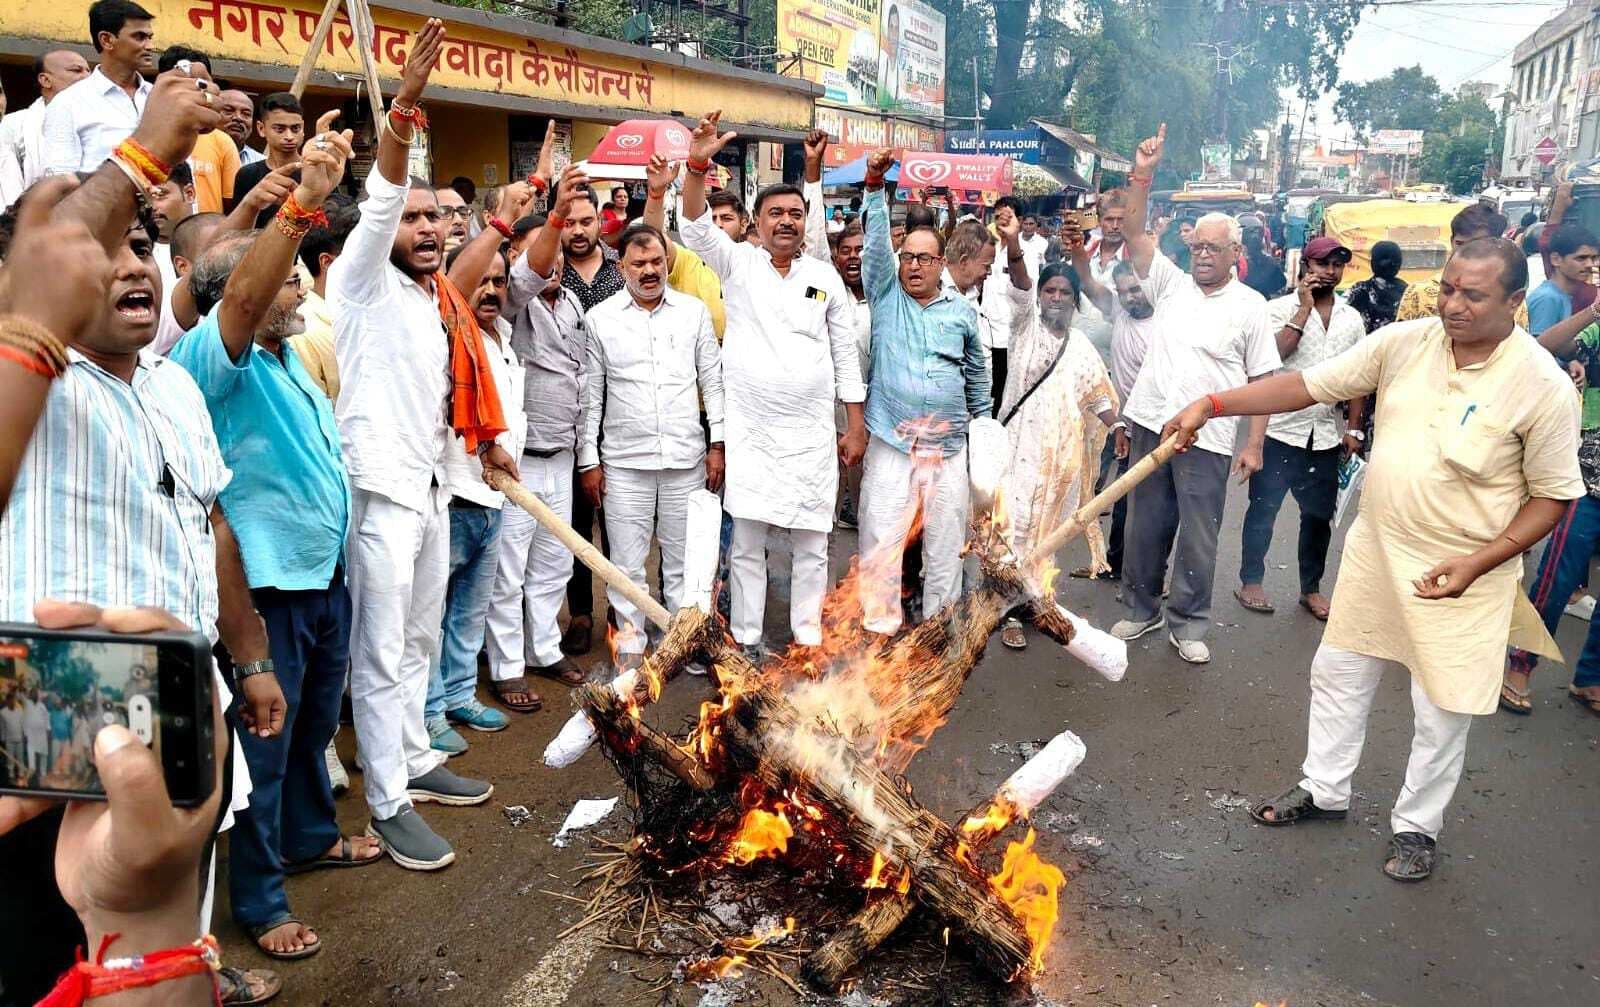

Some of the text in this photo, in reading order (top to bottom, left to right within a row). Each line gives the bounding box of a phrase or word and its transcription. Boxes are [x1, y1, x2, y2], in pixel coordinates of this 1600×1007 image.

[187, 1, 288, 54] नगर
[413, 31, 516, 90] वादा
[519, 39, 548, 88] के
[550, 48, 632, 100] सौजन्य
[635, 62, 654, 106] से
[819, 45, 834, 64] FOR
[989, 140, 1040, 149] PARLOUR
